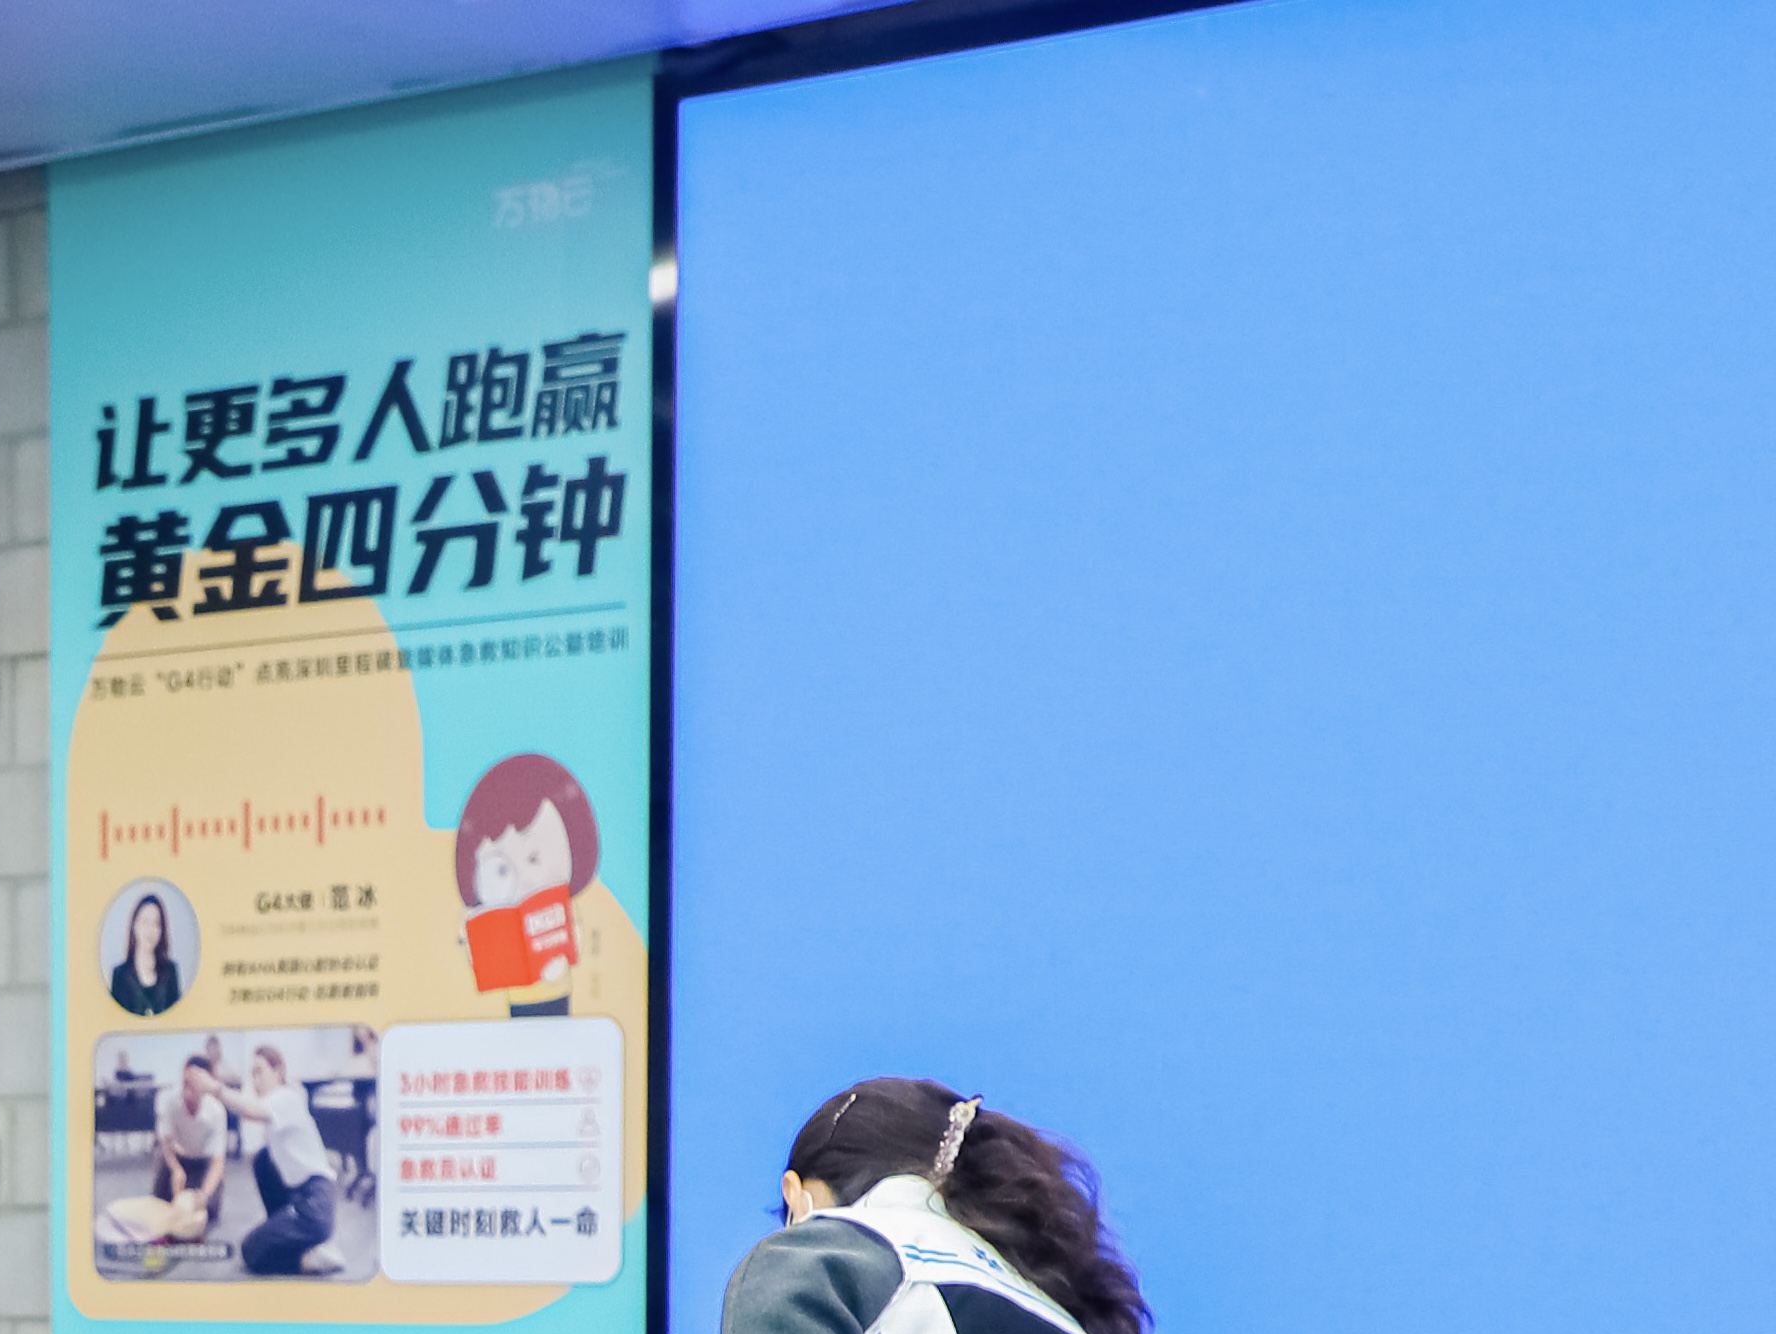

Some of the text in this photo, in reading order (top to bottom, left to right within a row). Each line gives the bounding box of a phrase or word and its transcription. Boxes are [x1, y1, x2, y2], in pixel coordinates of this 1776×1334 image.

[95, 331, 628, 491] 让更多人跑赢
[92, 455, 628, 629] 黄金四分钟
[401, 1206, 598, 1237] 关键时刻救人一命
